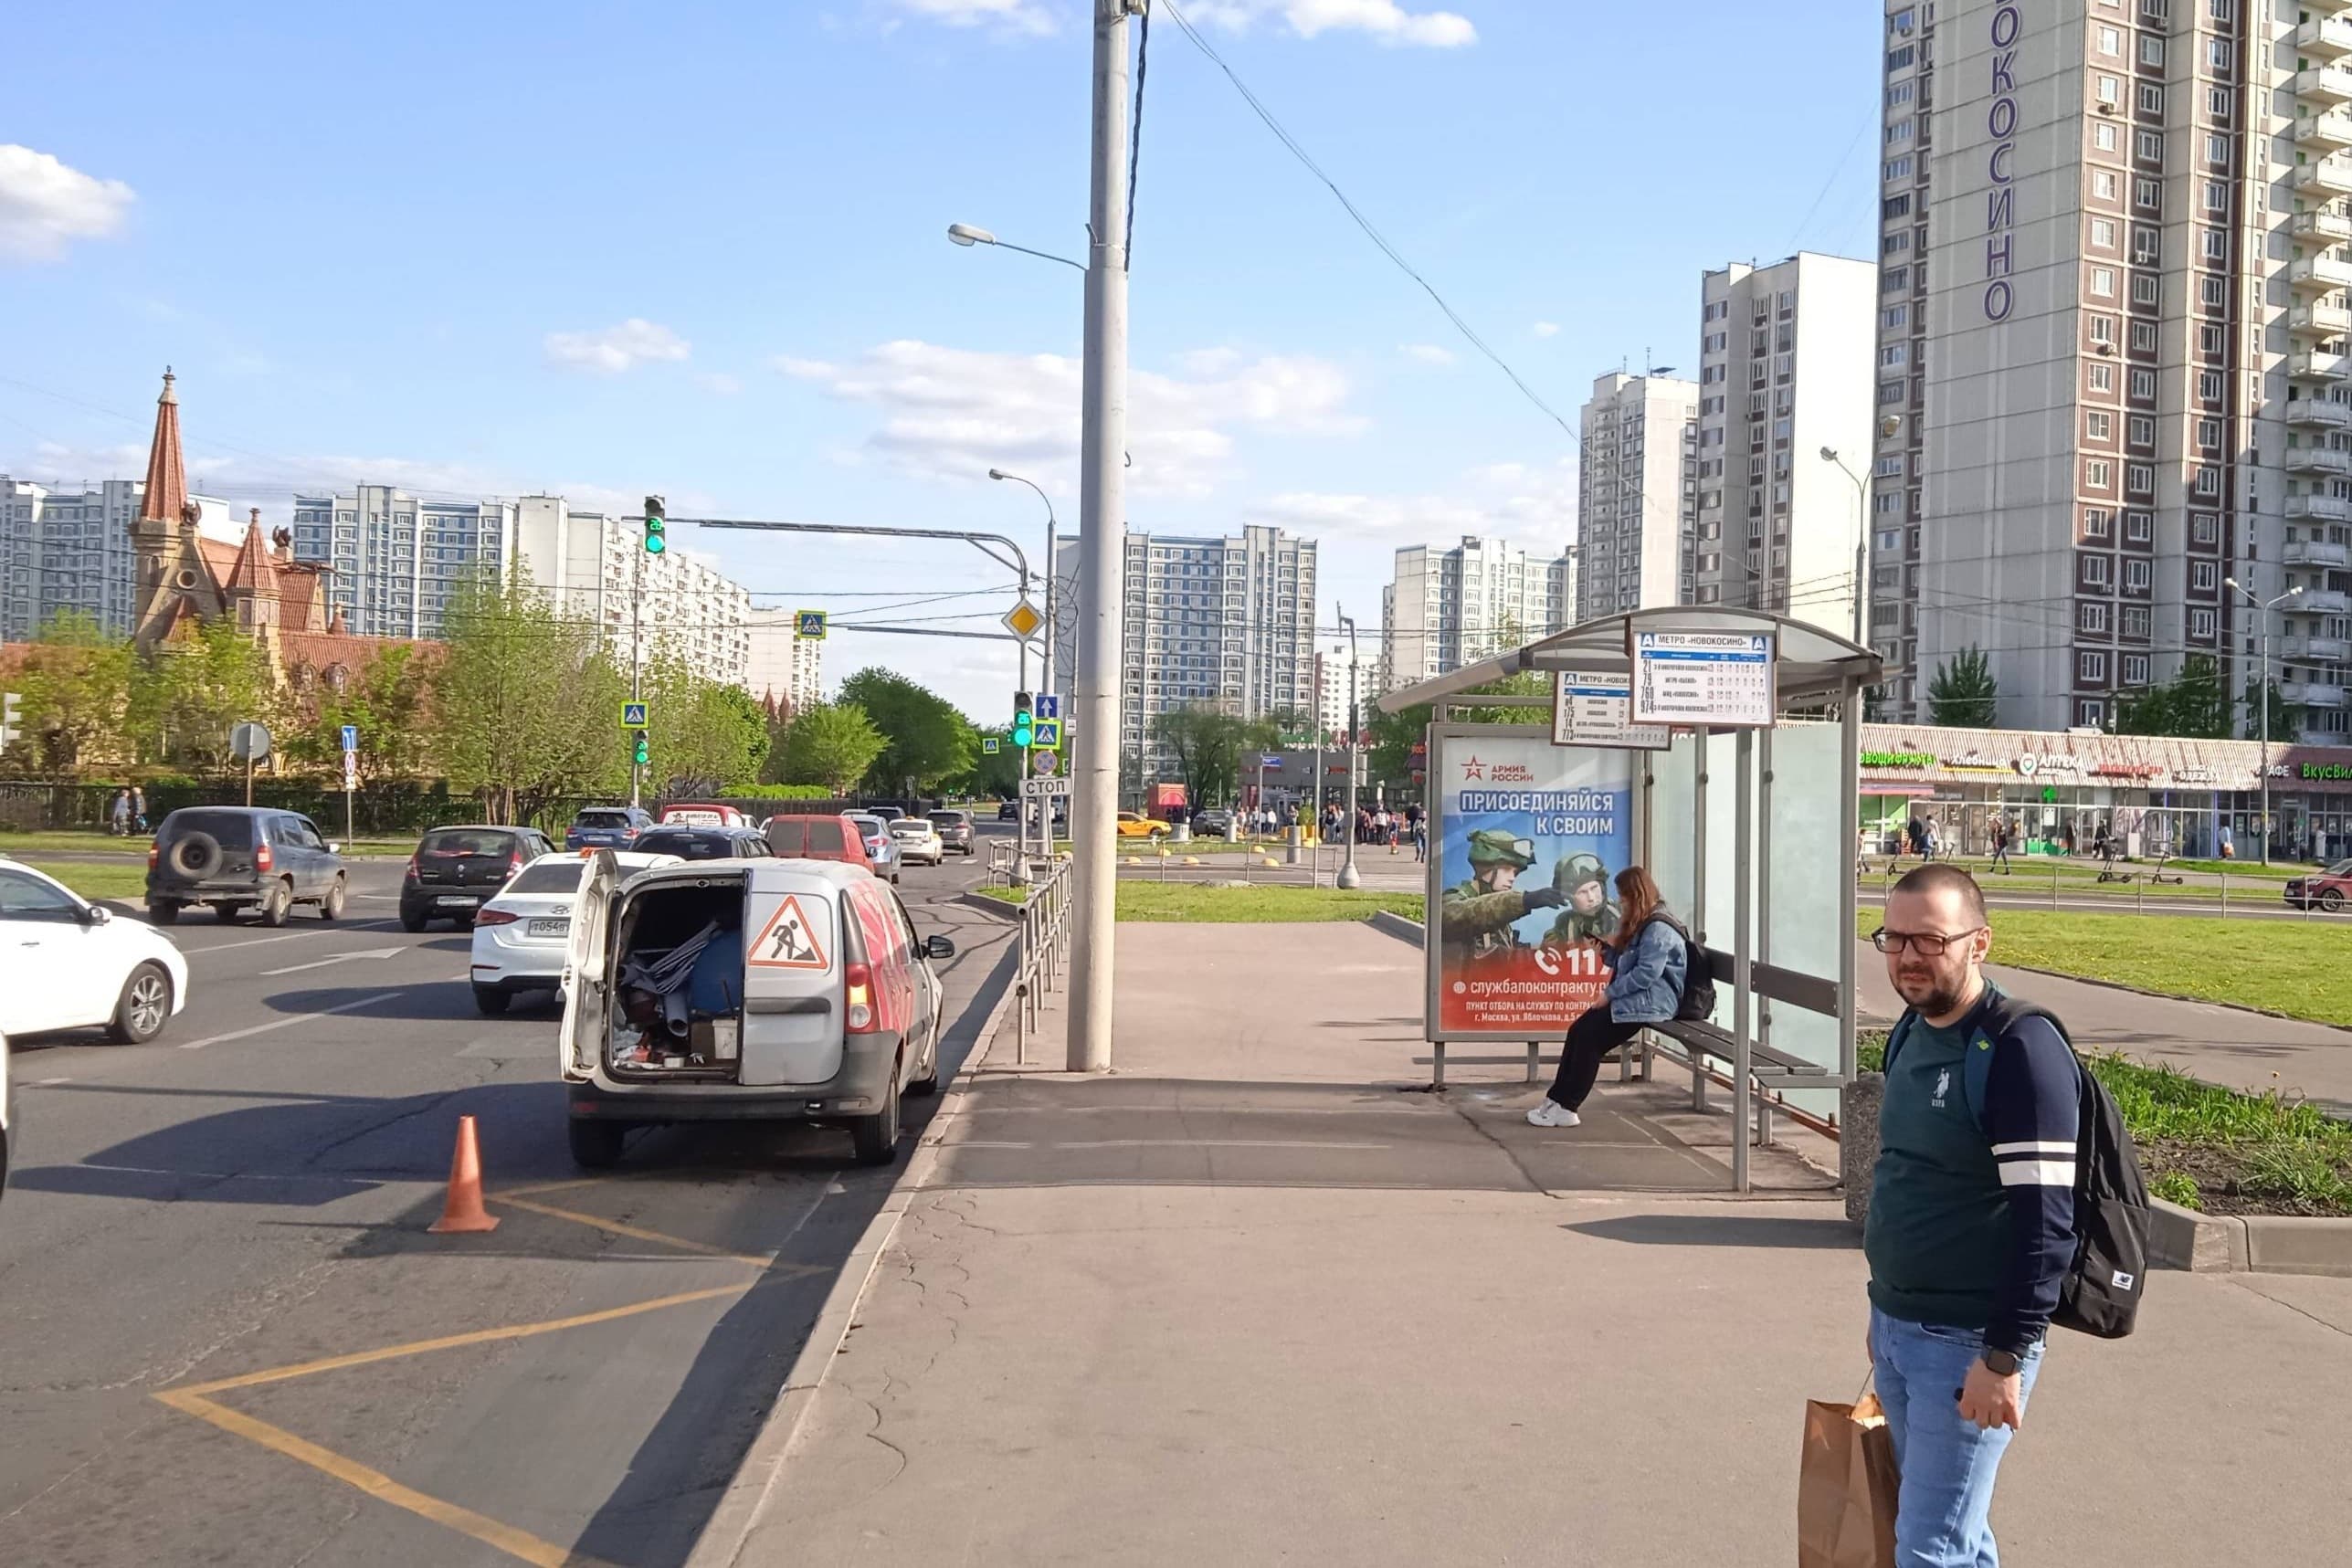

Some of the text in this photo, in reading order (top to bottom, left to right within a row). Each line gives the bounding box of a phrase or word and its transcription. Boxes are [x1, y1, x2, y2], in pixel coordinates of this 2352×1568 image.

[1984, 0, 2020, 321] ОКОСИНО
[1658, 635, 1685, 644] МЕТРО
[1687, 637, 1746, 647] «НОВОКОСИНО»
[1492, 765, 1526, 773] АРМИЯ
[1491, 773, 1534, 783] РОССИИ
[1026, 781, 1065, 795] СТОП
[1461, 790, 1614, 814] ПРИСОЕДИНЯЙСЯ
[1536, 817, 1614, 835] К СВОИМ
[1470, 978, 1610, 997] службапоконтракту.р
[1466, 1001, 1488, 1011] ПУНКТ
[1489, 1001, 1515, 1011] ОТБОРА
[1516, 1001, 1525, 1011] НА
[1526, 1001, 1554, 1011] СЛУЖБУ
[1555, 1001, 1565, 1011] ПО
